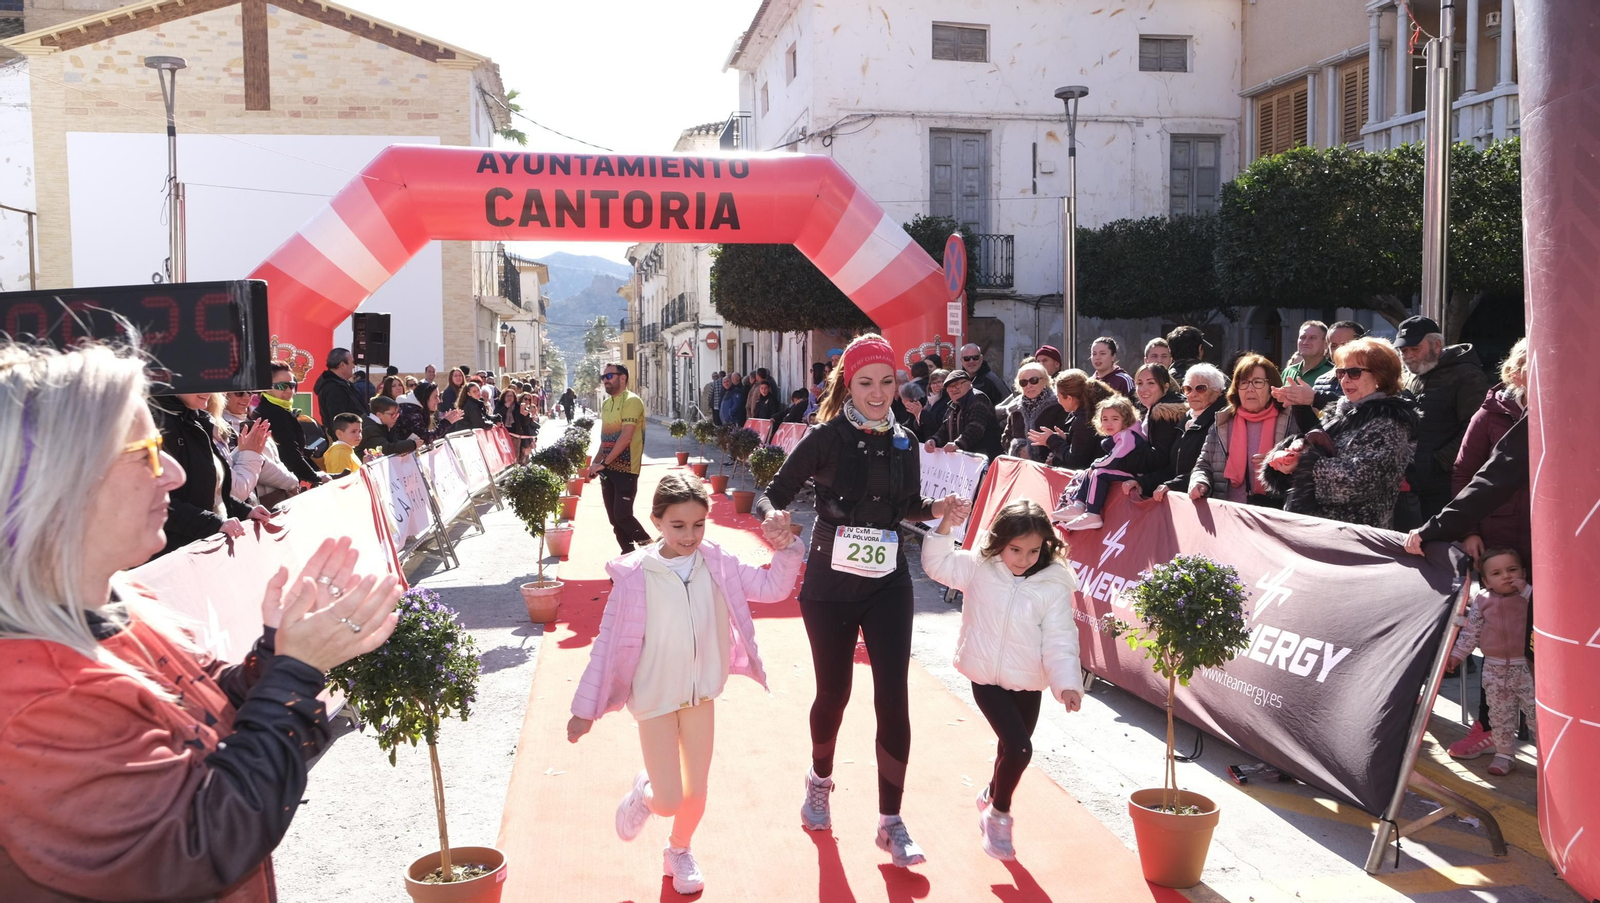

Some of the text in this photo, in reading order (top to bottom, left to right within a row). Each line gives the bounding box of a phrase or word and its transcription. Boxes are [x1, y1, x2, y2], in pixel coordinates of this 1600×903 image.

[477, 153, 750, 179] AYUNTAMIENTO
[485, 187, 741, 230] CANTORIA
[846, 543, 886, 565] 236
[1201, 665, 1284, 708] www.teamergy.es
